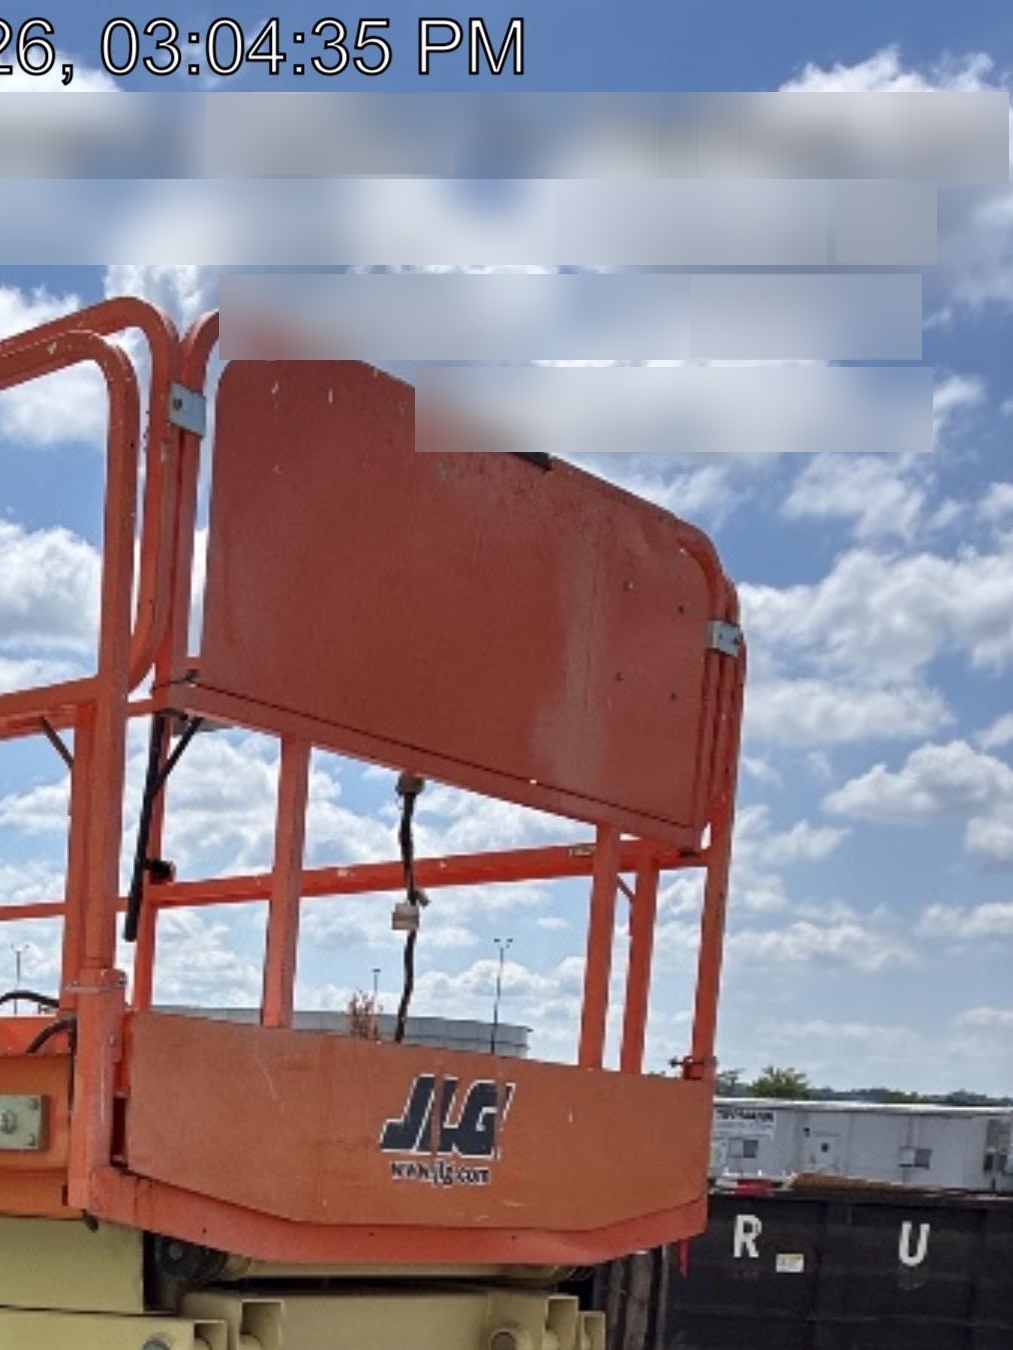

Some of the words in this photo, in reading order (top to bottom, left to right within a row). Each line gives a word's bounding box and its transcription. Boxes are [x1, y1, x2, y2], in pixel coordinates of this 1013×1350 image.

[379, 1073, 516, 1159] JLG
[733, 1214, 763, 1258] R
[897, 1220, 931, 1266] U
